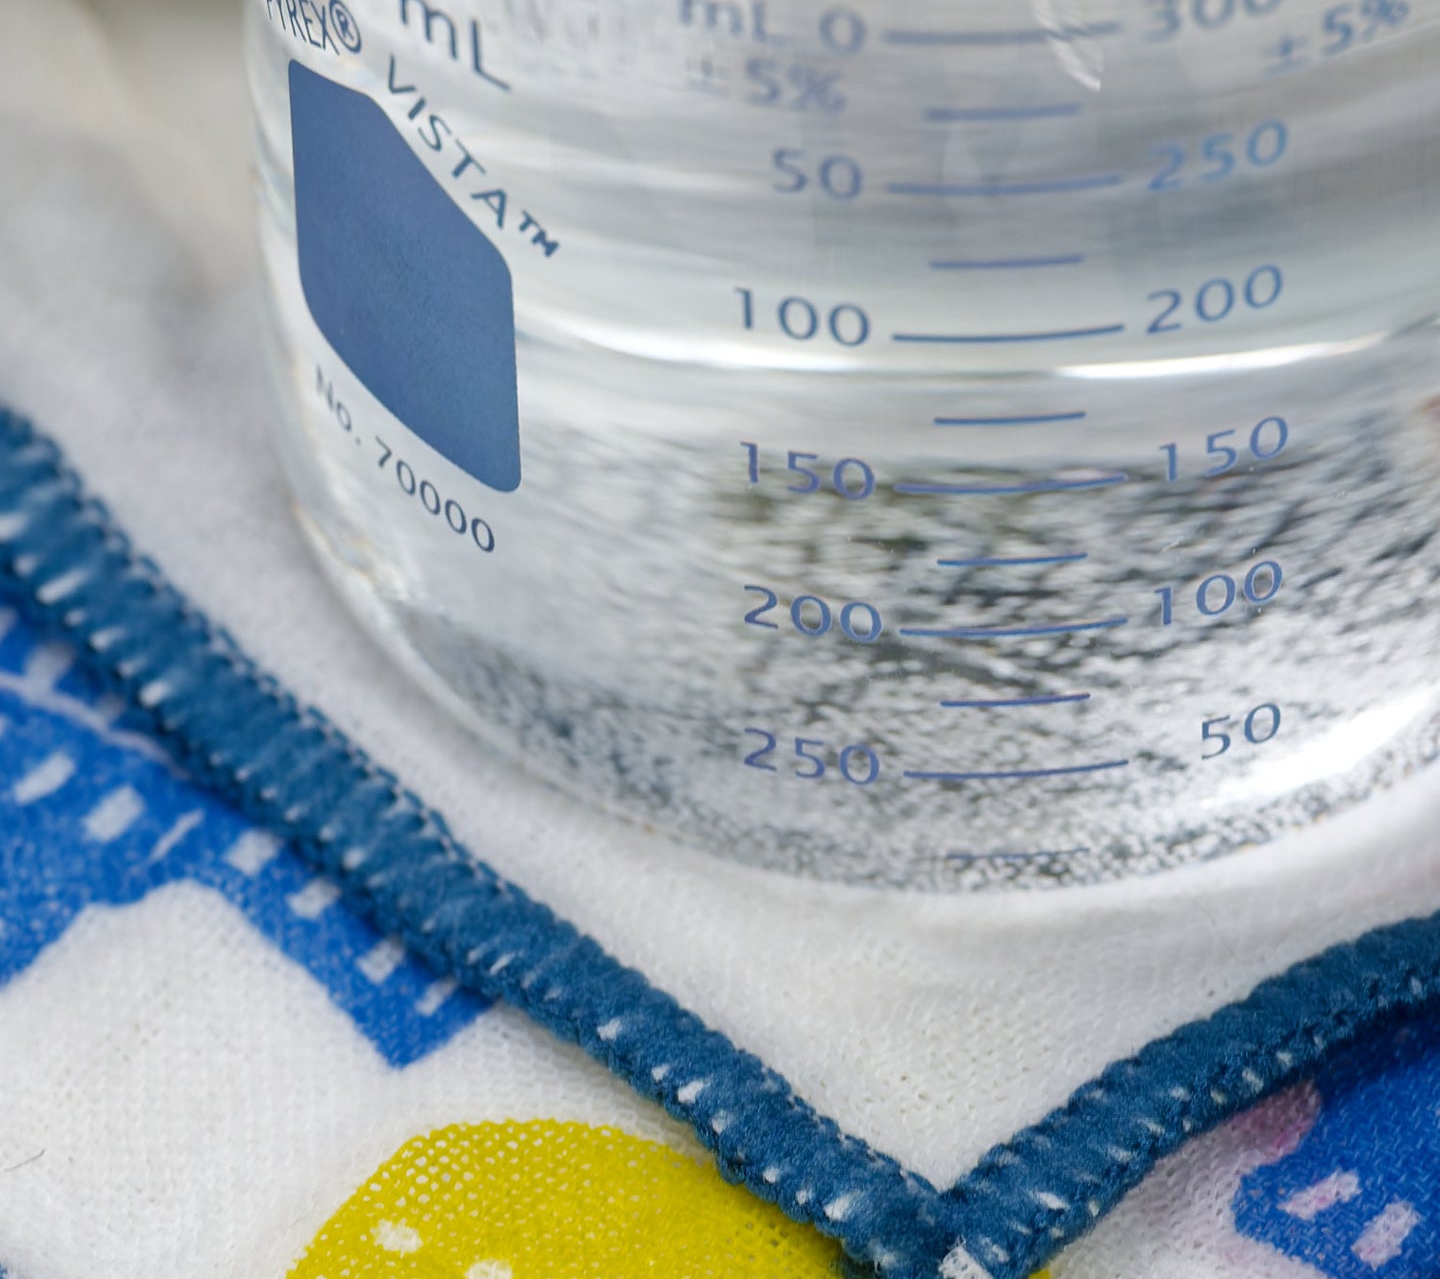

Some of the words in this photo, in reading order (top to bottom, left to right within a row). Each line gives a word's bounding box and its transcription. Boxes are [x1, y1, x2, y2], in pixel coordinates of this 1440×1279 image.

[818, 3, 867, 57] 0
[772, 145, 864, 202] 50
[1146, 118, 1290, 192] 250
[734, 286, 872, 347] 100
[1146, 263, 1284, 335] 200
[740, 441, 877, 501] 150
[1158, 415, 1289, 483] 150
[374, 434, 496, 554] 70000
[743, 584, 883, 646] 200
[1154, 559, 1284, 626] 100
[743, 727, 881, 786] 250
[1200, 701, 1282, 762] 50
